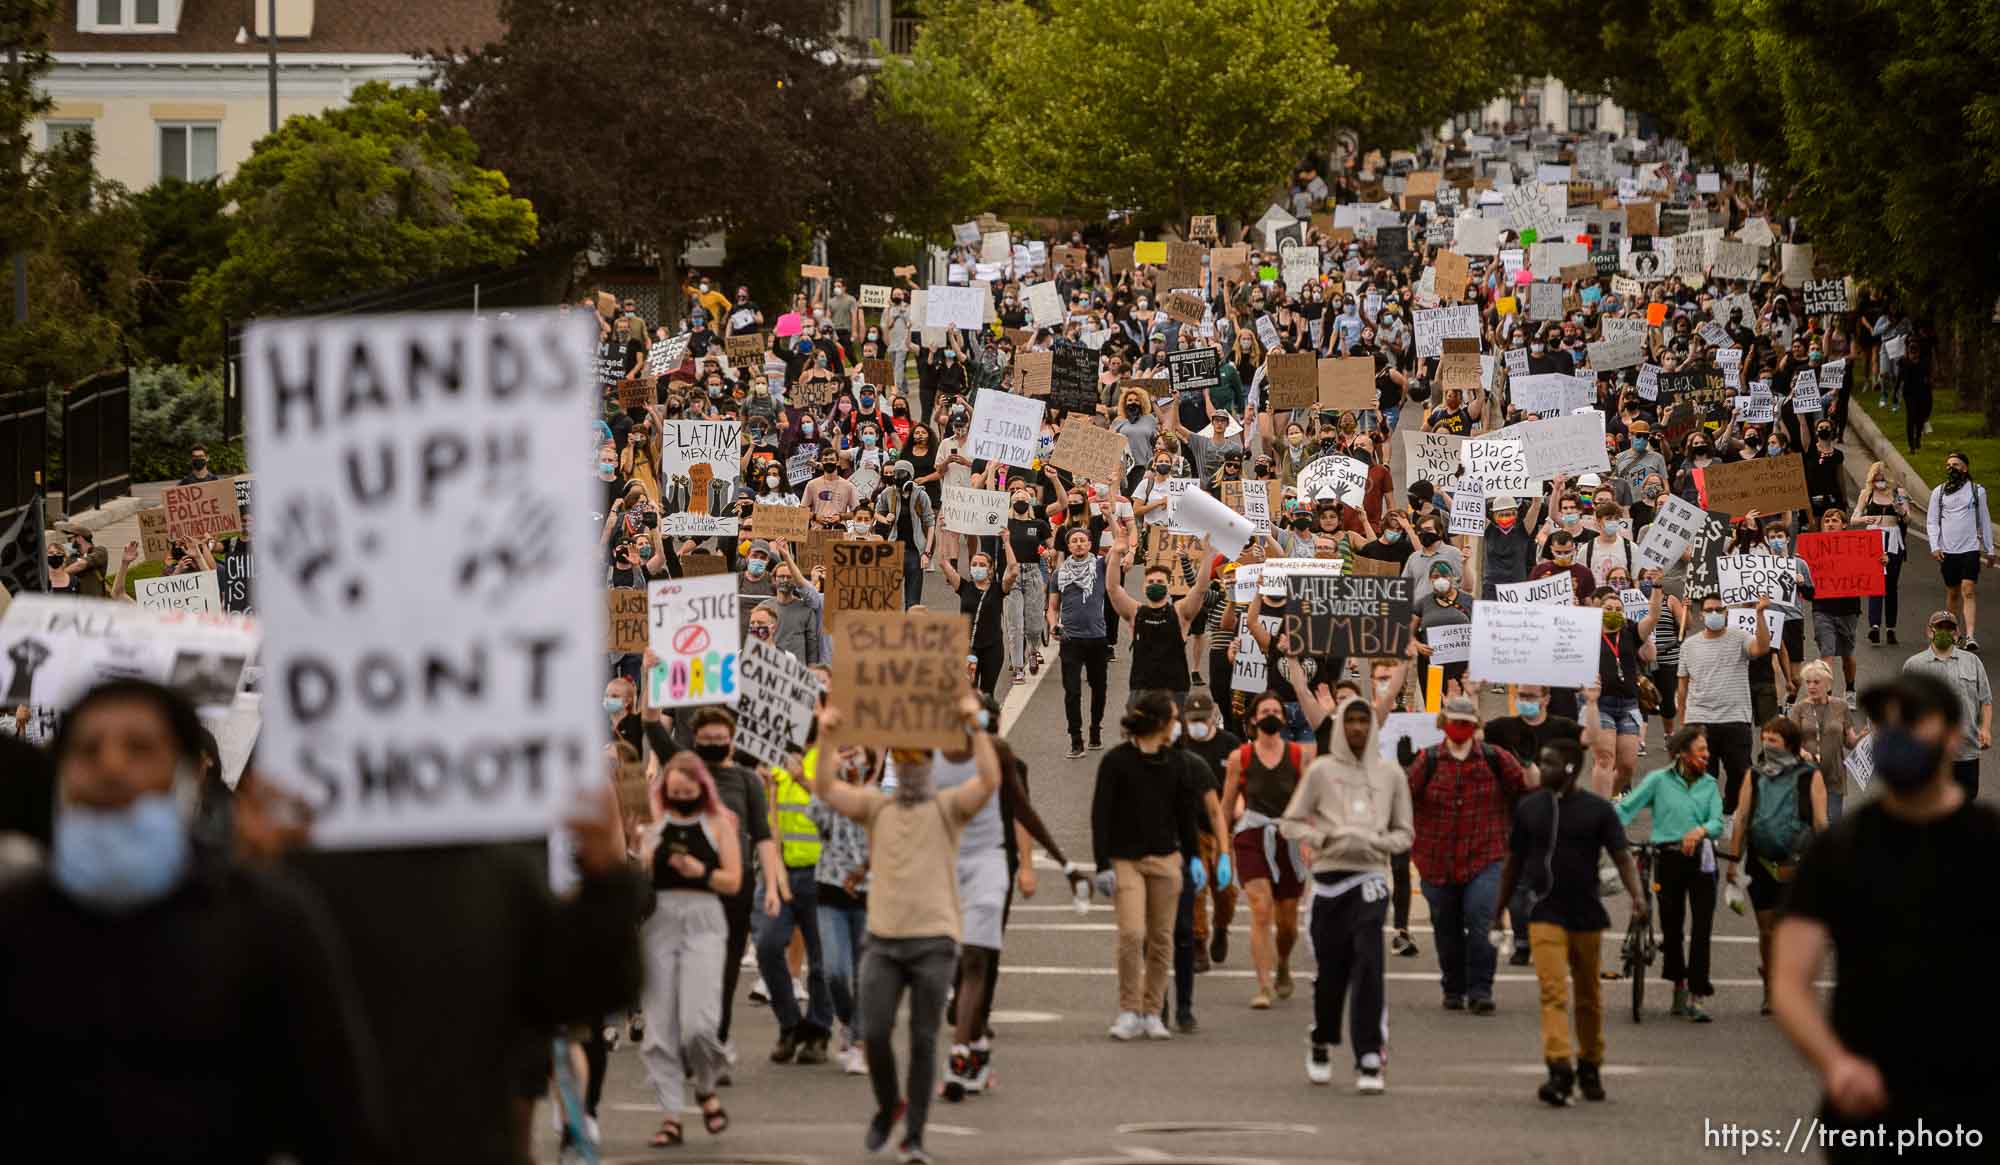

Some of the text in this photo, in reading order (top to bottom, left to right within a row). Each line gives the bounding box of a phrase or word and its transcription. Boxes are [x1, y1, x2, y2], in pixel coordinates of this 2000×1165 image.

[1804, 278, 1843, 292] BLACK
[1804, 291, 1843, 303] LIVES
[1805, 300, 1848, 314] MATTER
[1506, 351, 1525, 359] BLACK
[263, 329, 580, 437] HANDS
[794, 384, 830, 396] JUSTICE
[1660, 376, 1695, 392] BLACK
[1796, 386, 1816, 396] LIVES
[1793, 399, 1822, 409] MATTER
[677, 423, 741, 449] LATINX
[983, 417, 1032, 441] I STAND
[1426, 434, 1448, 447] NO
[681, 448, 730, 462] MEXICA
[975, 440, 1031, 464] WITH YOU
[1310, 457, 1351, 471] HANDS
[1428, 458, 1450, 472] NO
[1472, 457, 1524, 473] Lives
[1457, 479, 1483, 494] BLACK
[166, 486, 203, 506] END
[168, 498, 220, 520] POLICE
[1456, 502, 1481, 513] LIVES
[1451, 517, 1485, 530] MATTER
[833, 543, 895, 566] STOP
[1719, 555, 1796, 572] JUSTICE
[832, 567, 903, 592] KILLING
[1740, 571, 1778, 585] FOR
[1287, 578, 1408, 602] WHITE SILENCE
[1498, 578, 1571, 604] NO JUSTICE
[1722, 586, 1775, 605] GEORGE
[838, 589, 896, 611] BLACK
[1312, 602, 1380, 616] IS VIOLENCE
[847, 621, 960, 651] BLACK
[751, 642, 782, 670] ALL
[285, 630, 567, 724] DONT
[855, 655, 960, 690] LIVES
[758, 686, 793, 715] UNTIL
[737, 693, 799, 740] BLACK
